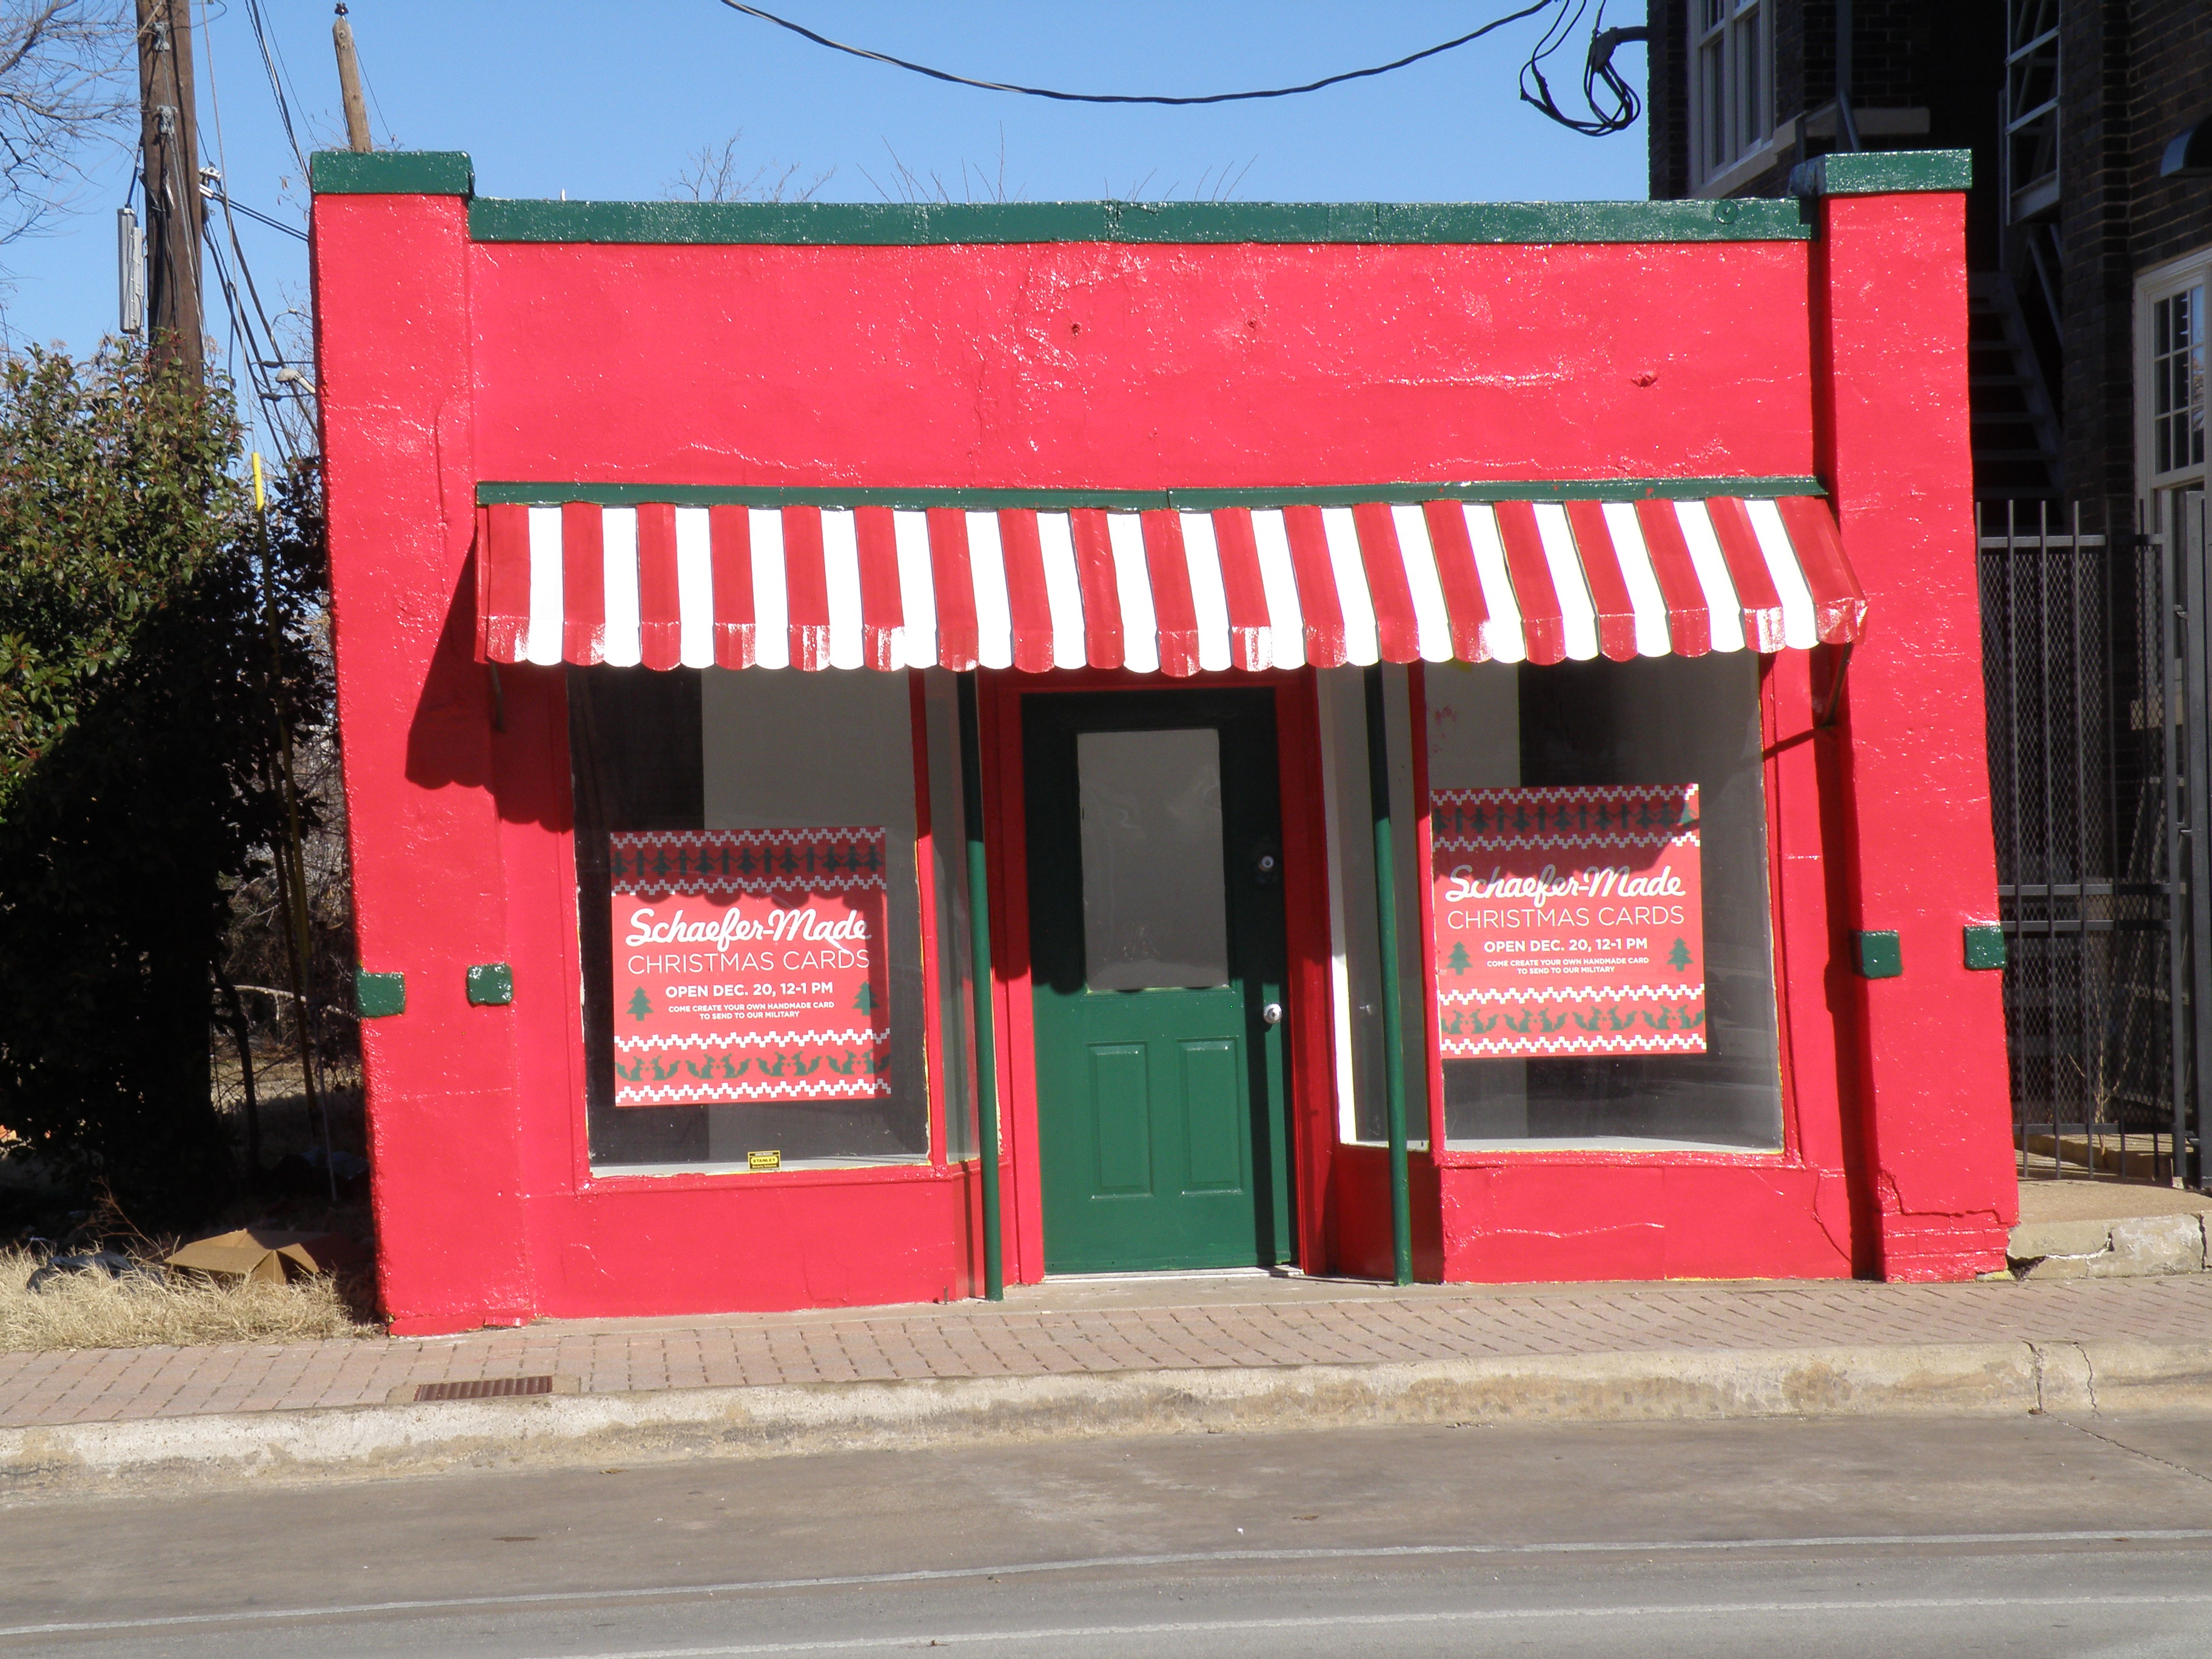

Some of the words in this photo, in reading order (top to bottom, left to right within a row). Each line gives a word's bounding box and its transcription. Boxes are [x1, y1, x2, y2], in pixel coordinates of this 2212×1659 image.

[1445, 863, 1686, 908] Schaefer-Made
[625, 907, 872, 951] Schaefer-Made
[1447, 908, 1589, 929] CHRISTMAS
[1598, 906, 1684, 927] CARDS
[1484, 939, 1526, 953] OPEN
[1530, 939, 1564, 951] DEC.
[1569, 939, 1592, 953] 20,
[1595, 939, 1623, 950] 12-1
[1627, 937, 1648, 950] PM
[627, 951, 775, 974] CHRISTMAS
[783, 948, 870, 970] CARDS
[665, 984, 708, 998] OPEN
[713, 984, 749, 997] DEC.
[752, 983, 777, 997] 20,
[780, 982, 807, 995] 12-1
[811, 981, 833, 994] PM
